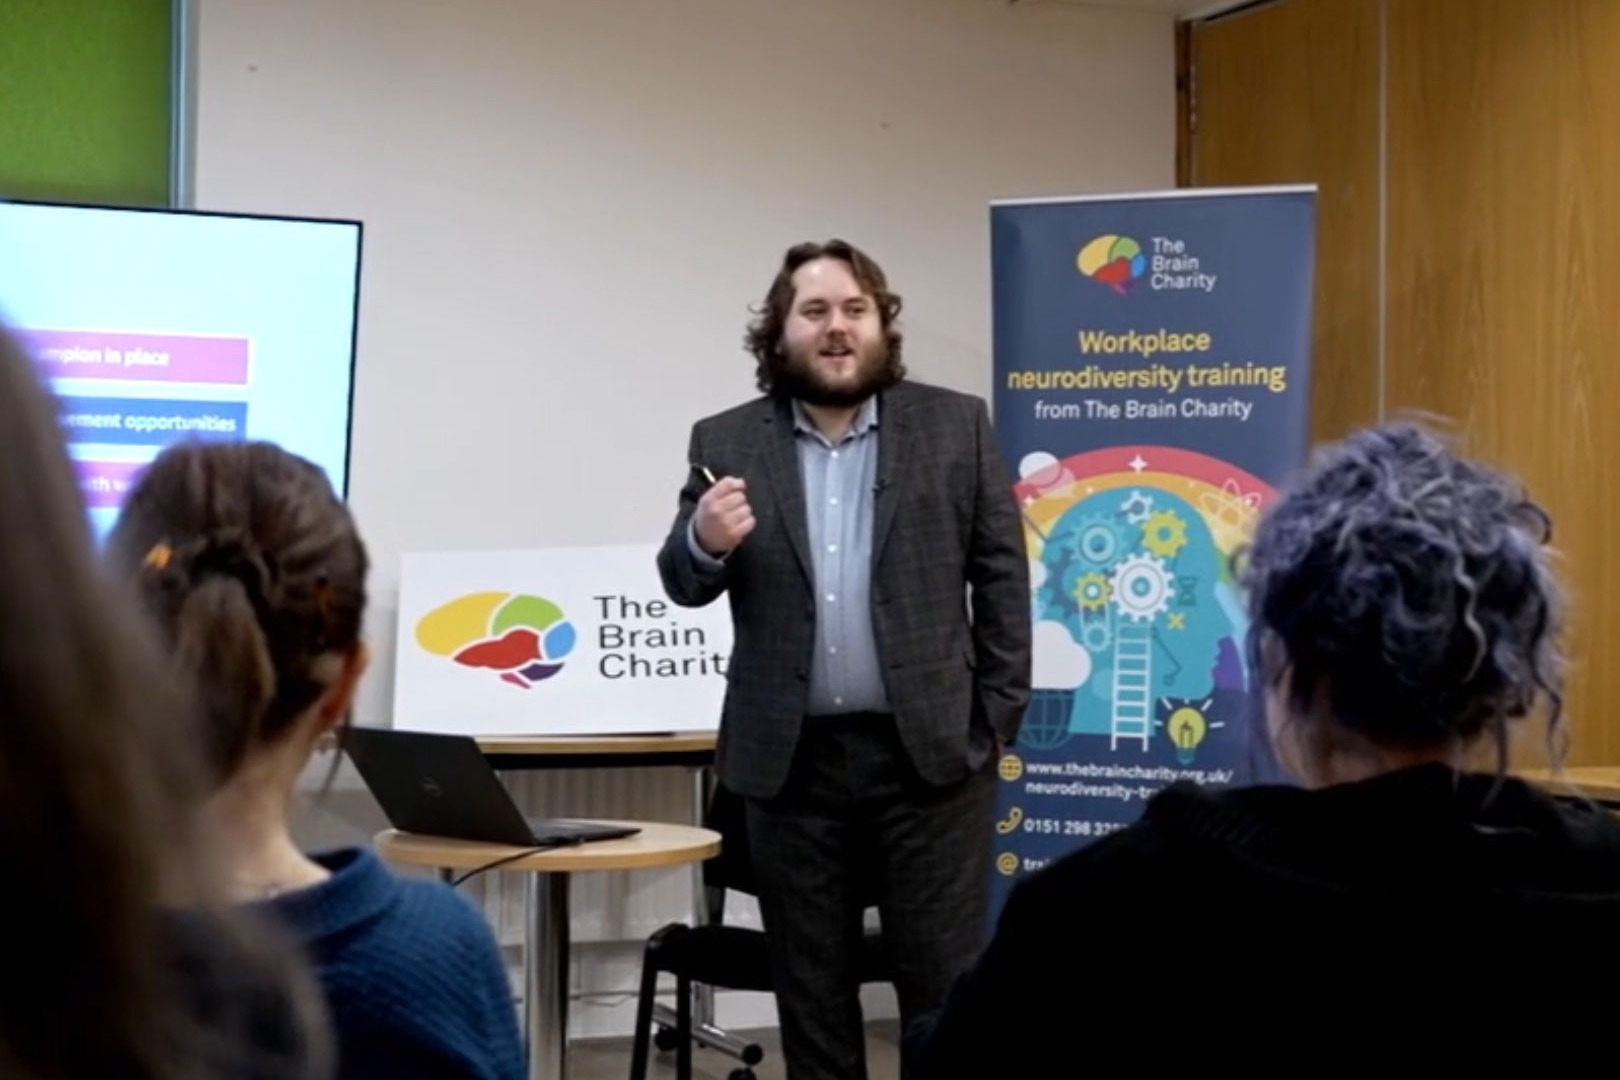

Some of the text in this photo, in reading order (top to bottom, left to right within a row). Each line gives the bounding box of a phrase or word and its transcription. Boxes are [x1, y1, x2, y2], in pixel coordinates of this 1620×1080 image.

[1152, 237, 1185, 253] The
[1152, 255, 1200, 272] Brain
[1151, 272, 1217, 293] Charity
[1078, 329, 1212, 358] Workplace
[104, 346, 122, 363] in
[124, 347, 170, 367] place
[1007, 362, 1287, 393] neurodiversity training
[1034, 398, 1253, 422] from The Brain Charity
[124, 413, 237, 433] opportunities
[593, 595, 668, 619] The
[598, 622, 705, 650] Brain
[598, 650, 729, 681] Charit
[1023, 818, 1060, 834] 0151
